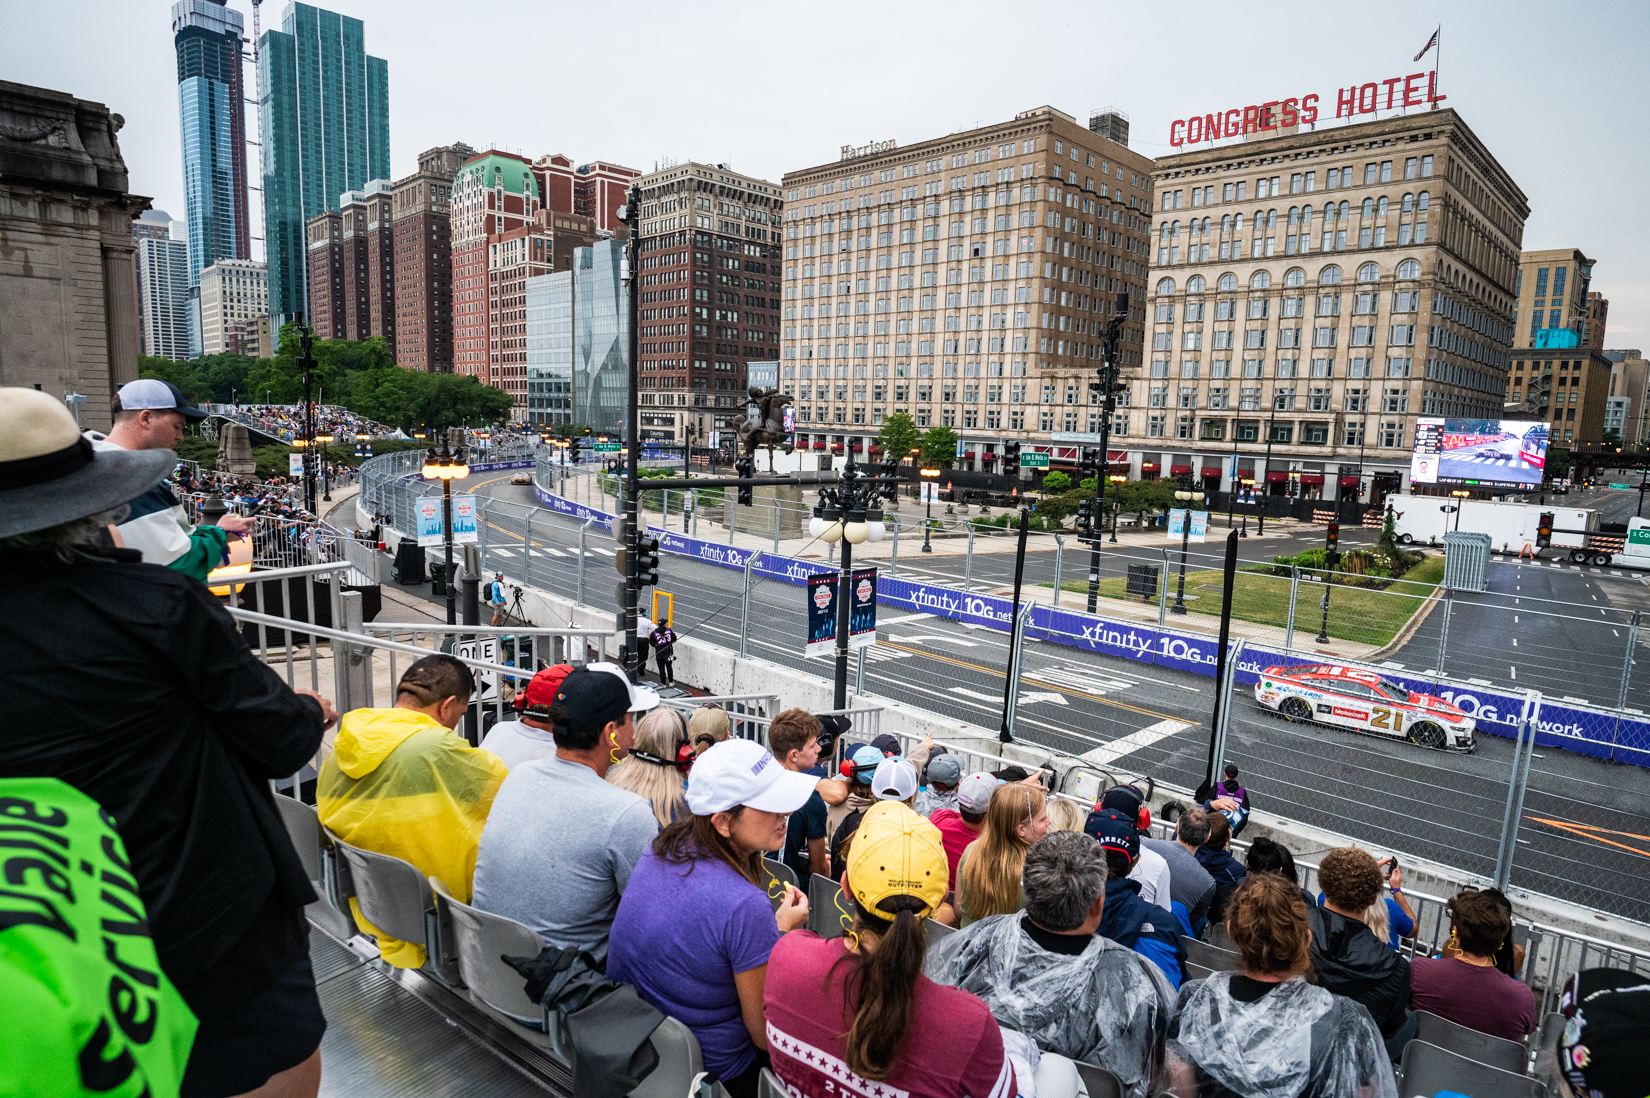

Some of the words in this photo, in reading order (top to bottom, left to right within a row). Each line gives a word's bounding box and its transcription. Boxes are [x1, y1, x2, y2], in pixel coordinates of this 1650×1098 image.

[1170, 93, 1319, 147] CONGRESS
[1336, 70, 1447, 119] HOTEL
[840, 139, 897, 160] Harrison
[700, 543, 726, 564] xfinity
[727, 549, 743, 565] 10G
[910, 588, 959, 616] xfinity
[964, 597, 994, 618] 10G
[1081, 622, 1152, 657] xfinity
[1159, 637, 1201, 663] 10G
[1303, 690, 1323, 699] Lane
[1335, 708, 1366, 719] Motorcraft
[1370, 706, 1403, 731] 21
[825, 1080, 835, 1094] 2
